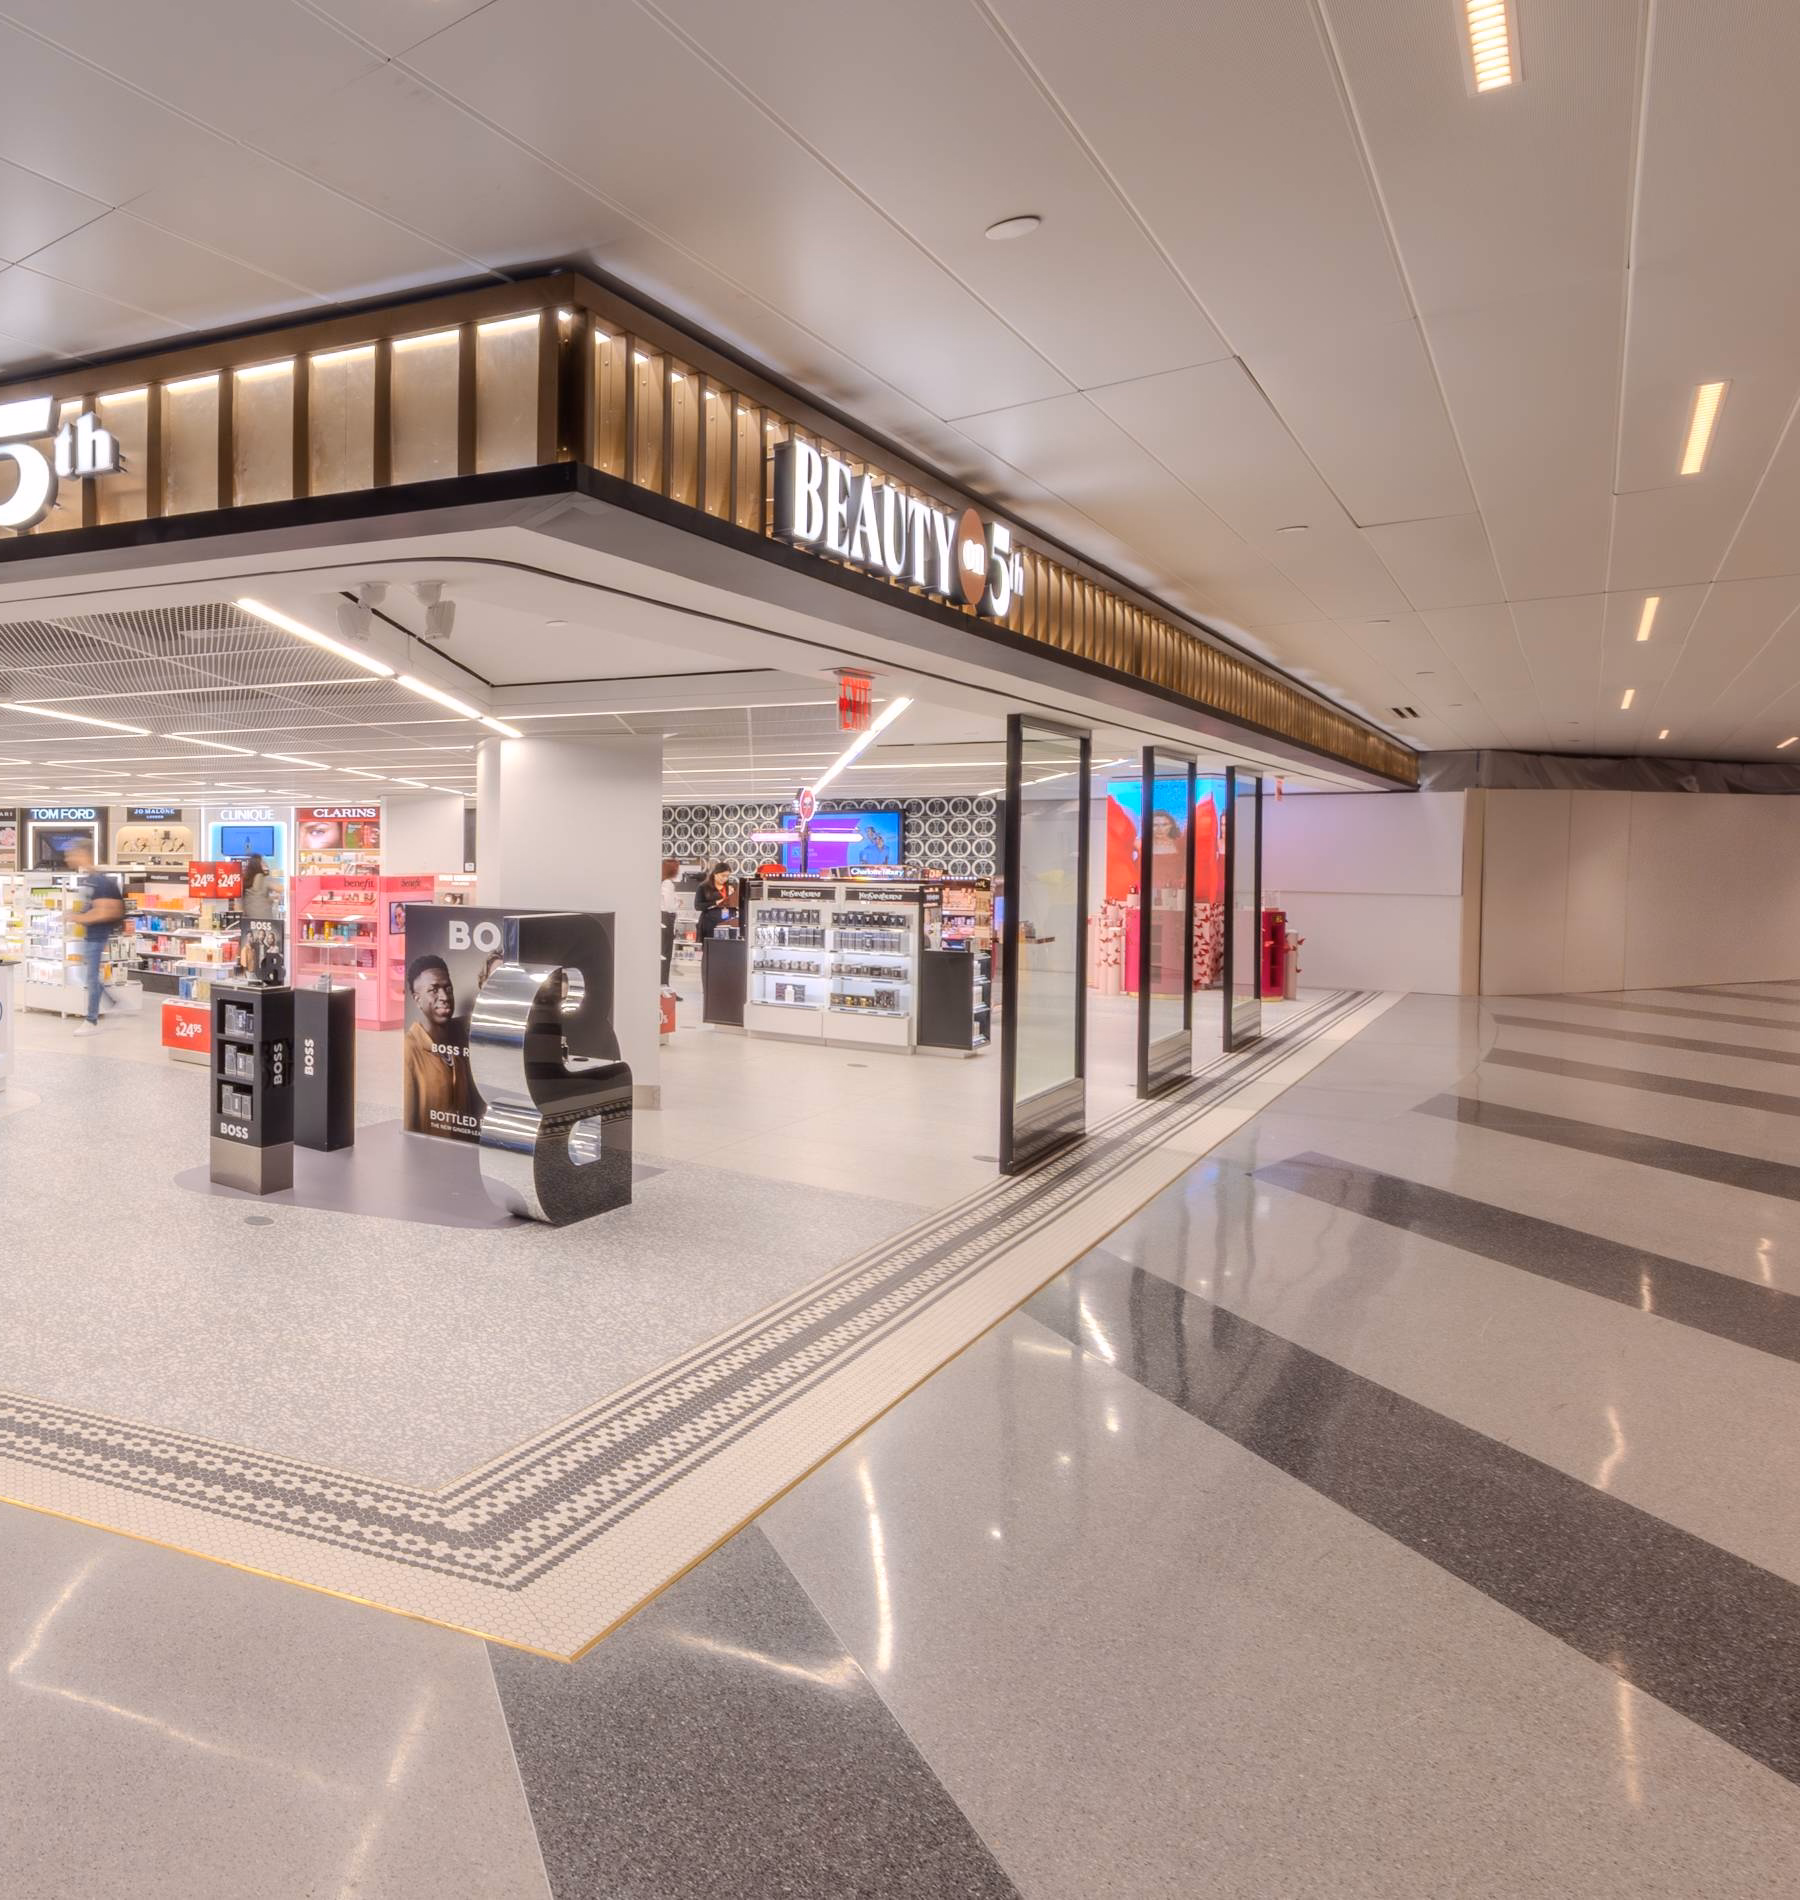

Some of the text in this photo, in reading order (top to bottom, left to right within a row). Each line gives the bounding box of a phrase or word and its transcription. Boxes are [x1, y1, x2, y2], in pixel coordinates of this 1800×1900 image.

[790, 438, 1025, 616] BEAUTY on 5th
[31, 808, 96, 820] TOM FORD
[220, 809, 276, 822] CLINIQUE
[313, 808, 376, 818] CLARINS
[344, 877, 374, 890] benefit
[250, 920, 272, 931] BOSS
[448, 920, 502, 952] BO
[431, 1043, 460, 1056] BOSS
[273, 1042, 283, 1085] BOSS
[304, 1038, 315, 1076] BOSS
[430, 1109, 478, 1128] BOTTLED
[220, 1122, 249, 1140] BOSS
[453, 1125, 482, 1137] GINGER-LEA
